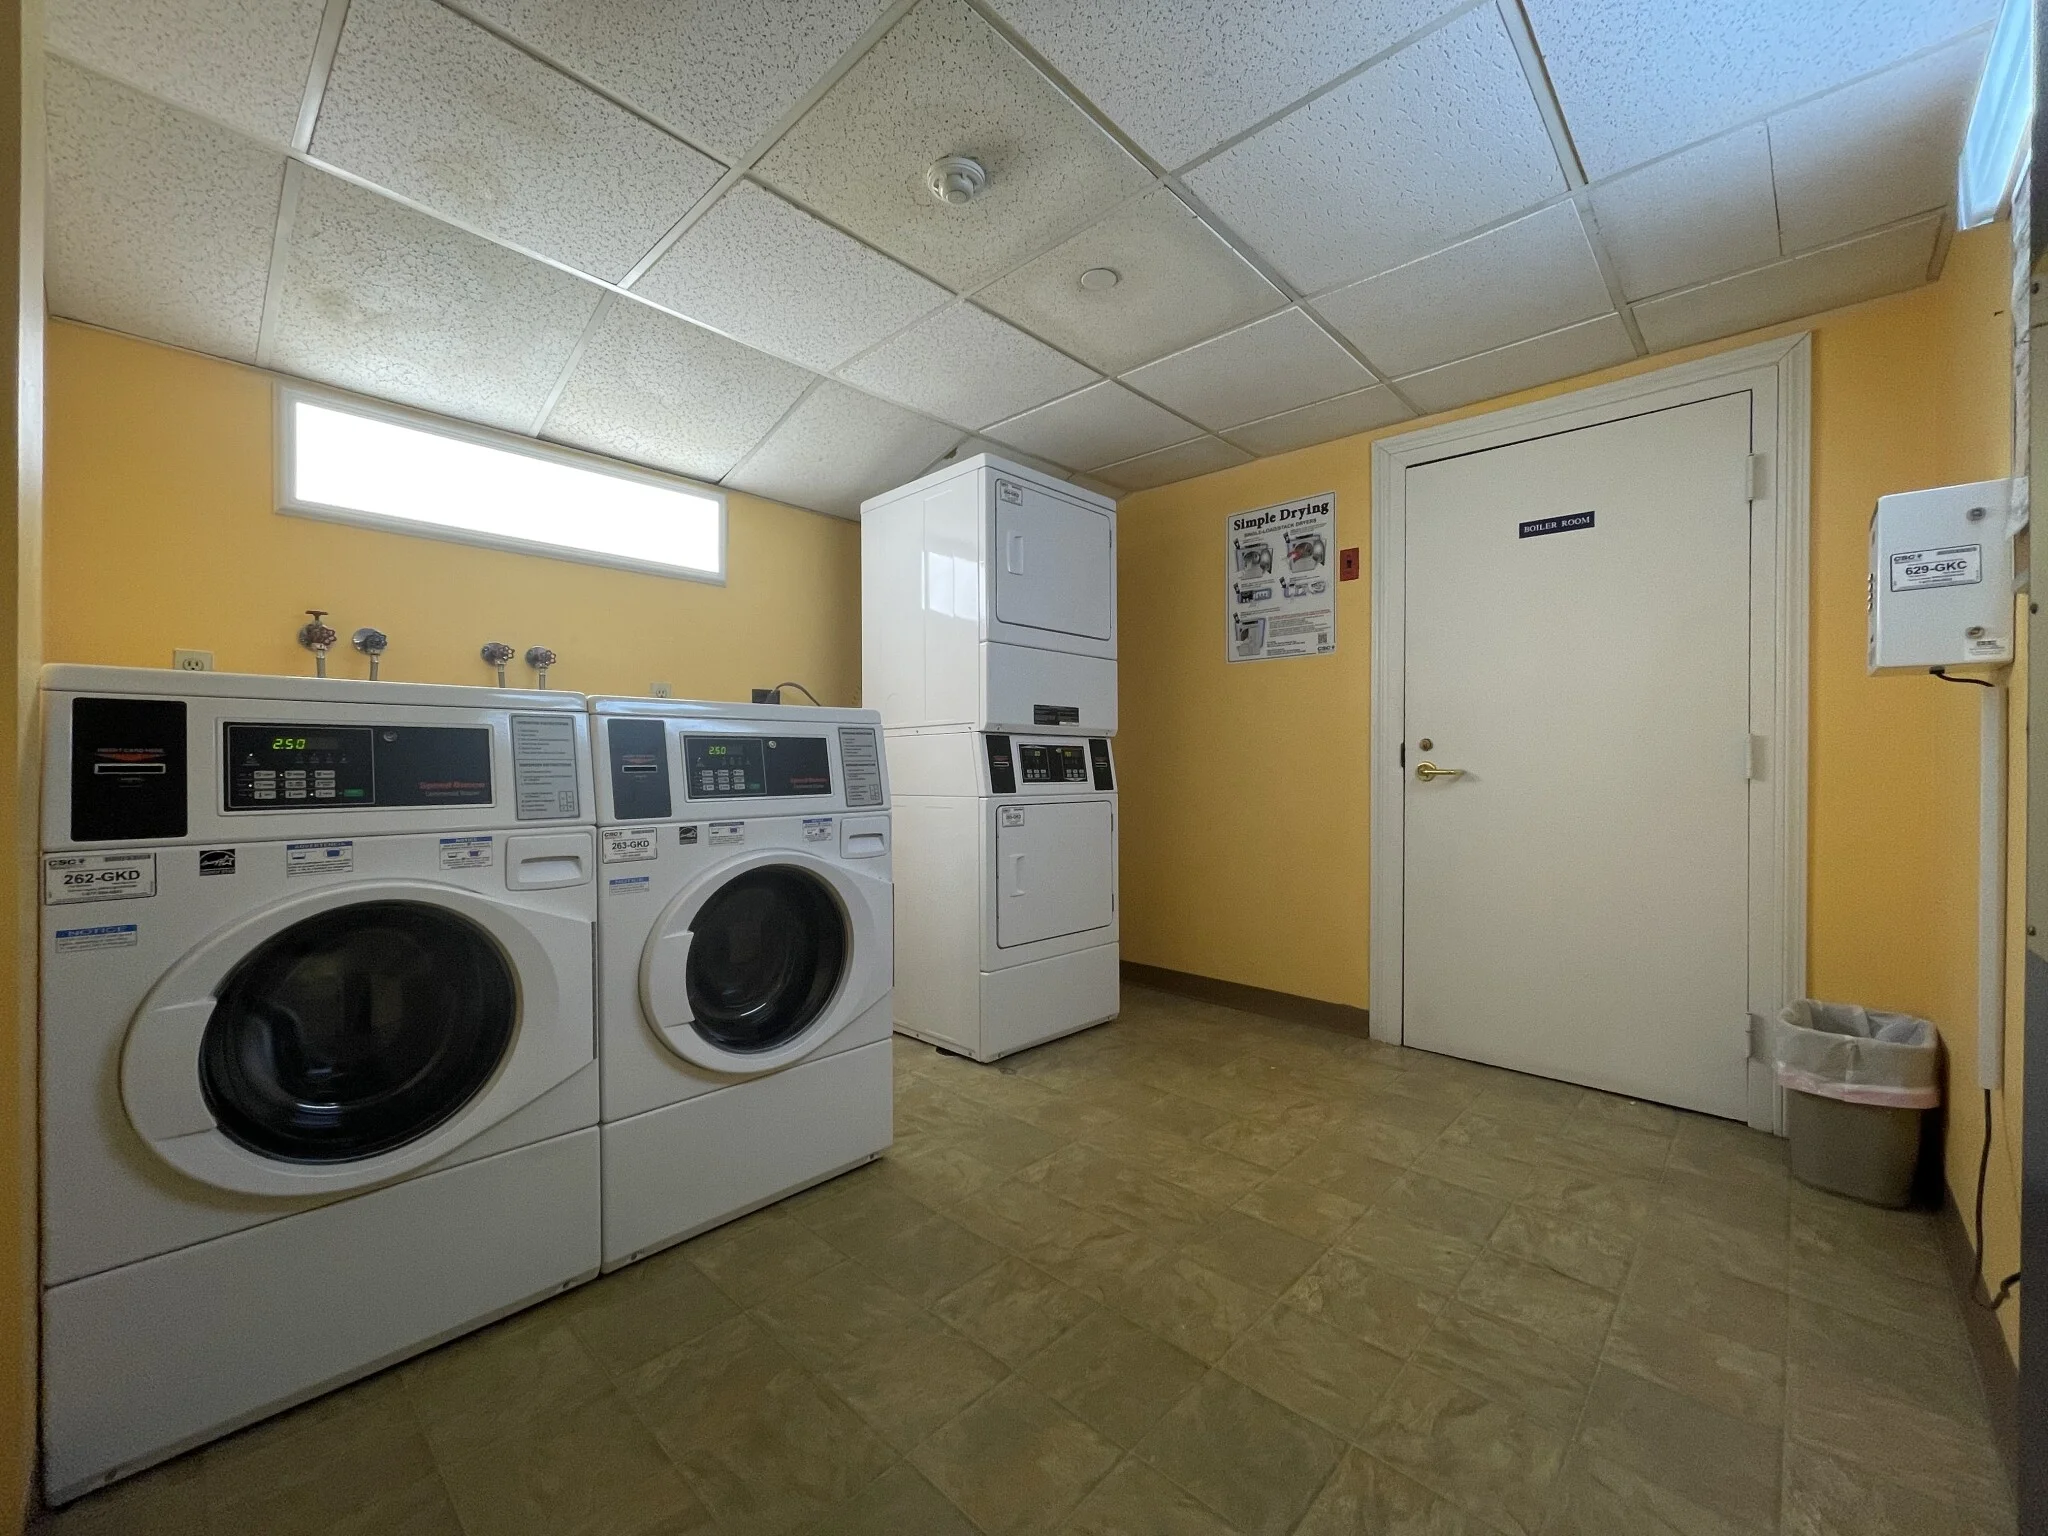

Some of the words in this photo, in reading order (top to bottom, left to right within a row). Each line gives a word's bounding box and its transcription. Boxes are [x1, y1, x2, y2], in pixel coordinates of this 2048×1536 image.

[1233, 512, 1276, 531] Simple
[1280, 502, 1330, 521] Drying
[1523, 521, 1557, 533] BOILER
[1561, 516, 1590, 527] ROOM
[1893, 554, 1916, 562] CSC
[1905, 560, 1968, 576] 629-GKC
[272, 738, 306, 750] 2.50
[611, 840, 650, 851] 263-GKD
[48, 858, 77, 867] CSC
[63, 870, 141, 885] 262-GKD
[67, 926, 128, 937] NOTICE
